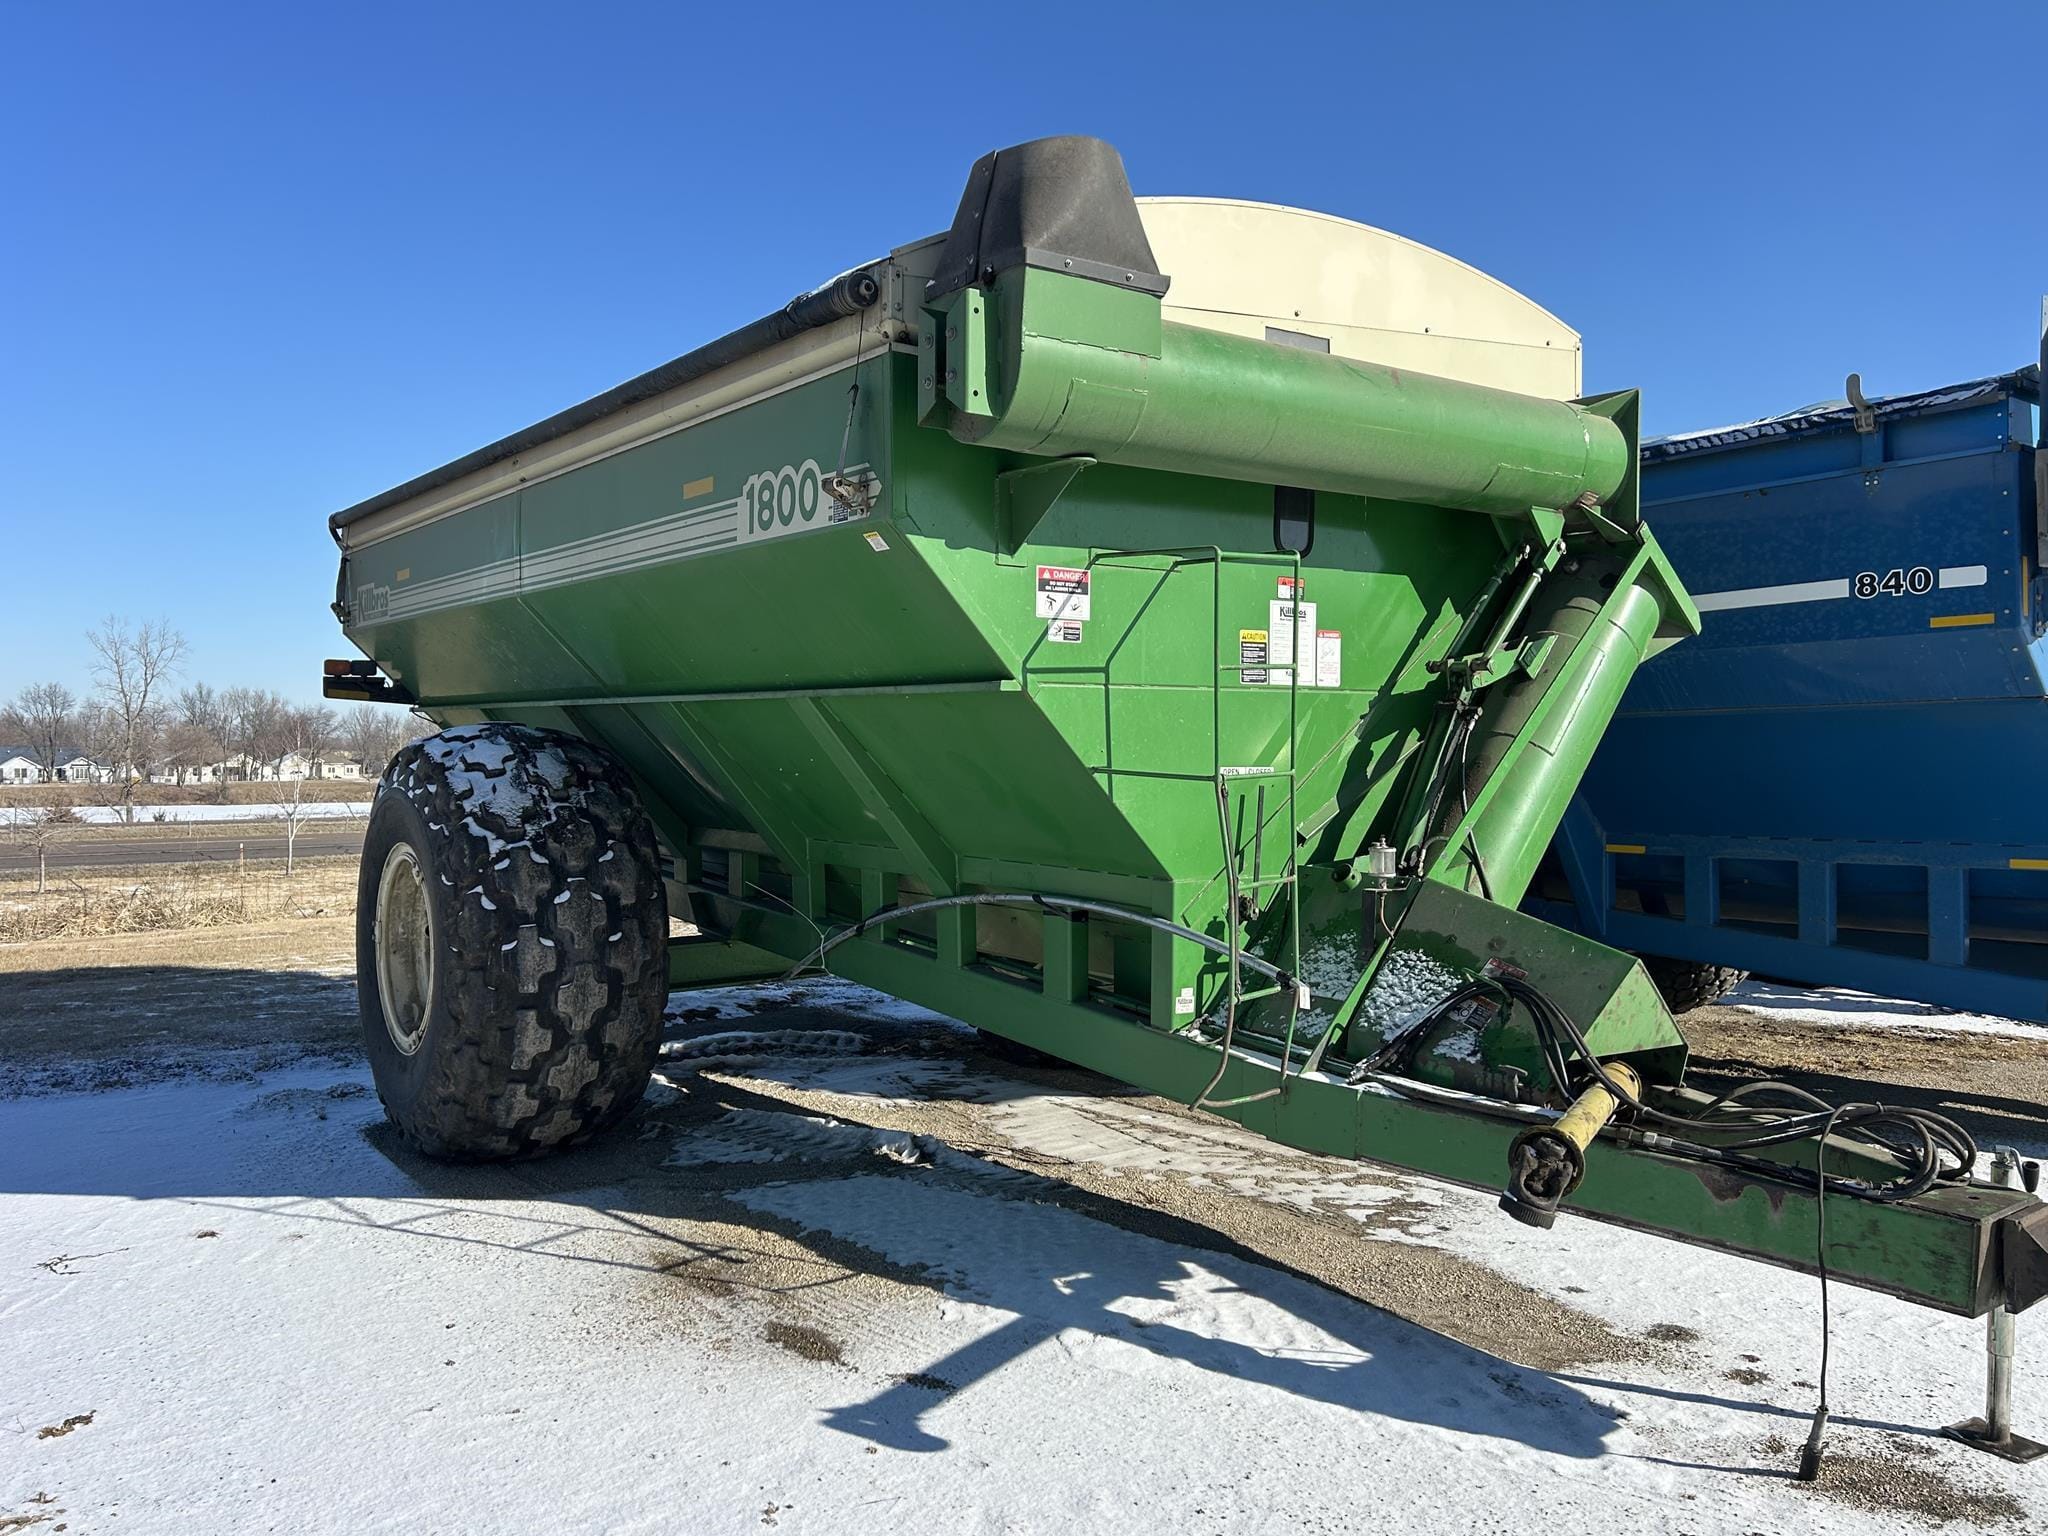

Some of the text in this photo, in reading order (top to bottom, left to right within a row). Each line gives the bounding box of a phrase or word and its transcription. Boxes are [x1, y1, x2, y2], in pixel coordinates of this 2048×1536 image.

[745, 467, 819, 535] 1800
[1855, 566, 1934, 599] 840
[358, 588, 389, 623] Killbros
[1280, 606, 1306, 618] Killos
[1247, 632, 1266, 641] CAUTION
[1223, 768, 1240, 776] OPEN
